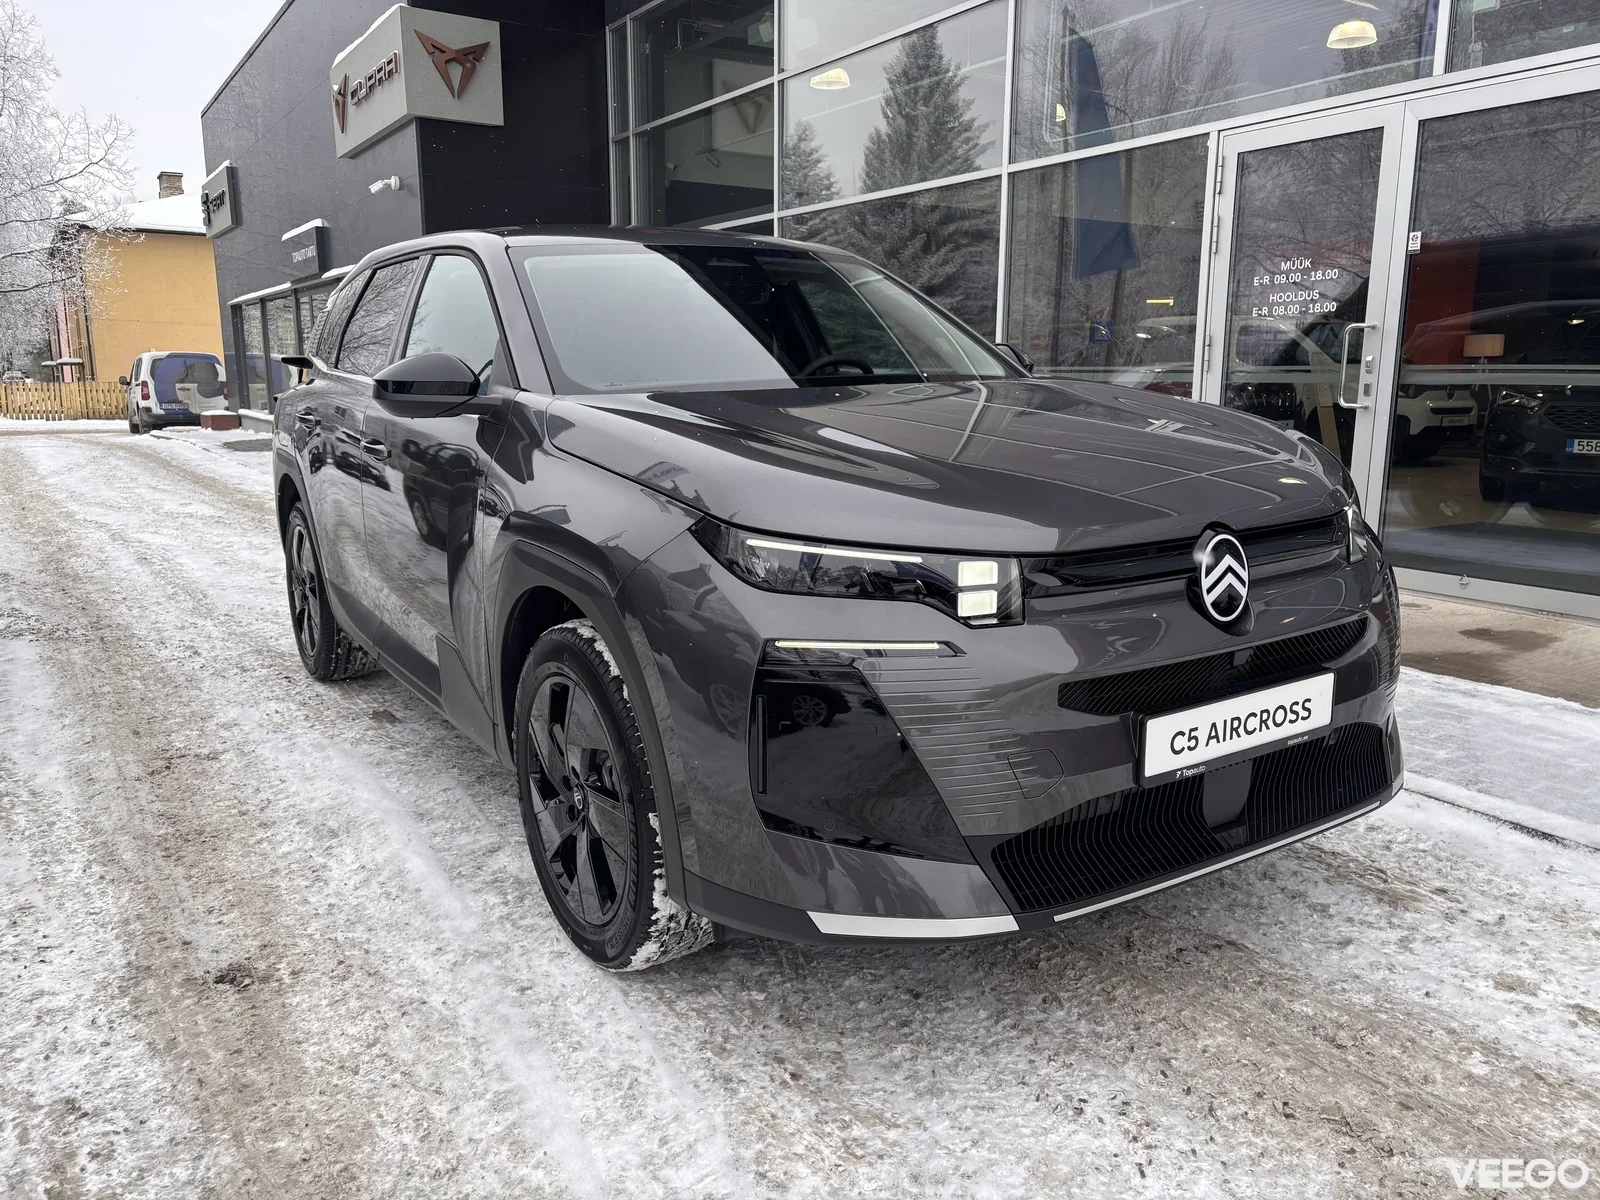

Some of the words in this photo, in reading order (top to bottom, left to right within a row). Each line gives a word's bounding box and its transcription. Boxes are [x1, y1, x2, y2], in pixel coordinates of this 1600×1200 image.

[350, 51, 399, 106] CUPRA
[1281, 257, 1312, 271] MÜÜK
[1253, 275, 1270, 286] E-R
[1274, 273, 1302, 284] 09.00
[1310, 269, 1339, 281] 18.00
[1269, 290, 1320, 303] HOOLDUS
[1252, 307, 1269, 317] E-R
[1272, 304, 1300, 316] 08.00
[1308, 302, 1337, 313] 18.00
[1170, 726, 1200, 756] C5
[1205, 698, 1312, 747] AIRCROSS
[1287, 735, 1309, 746] topauto.ee
[1183, 764, 1206, 777] Topauto
